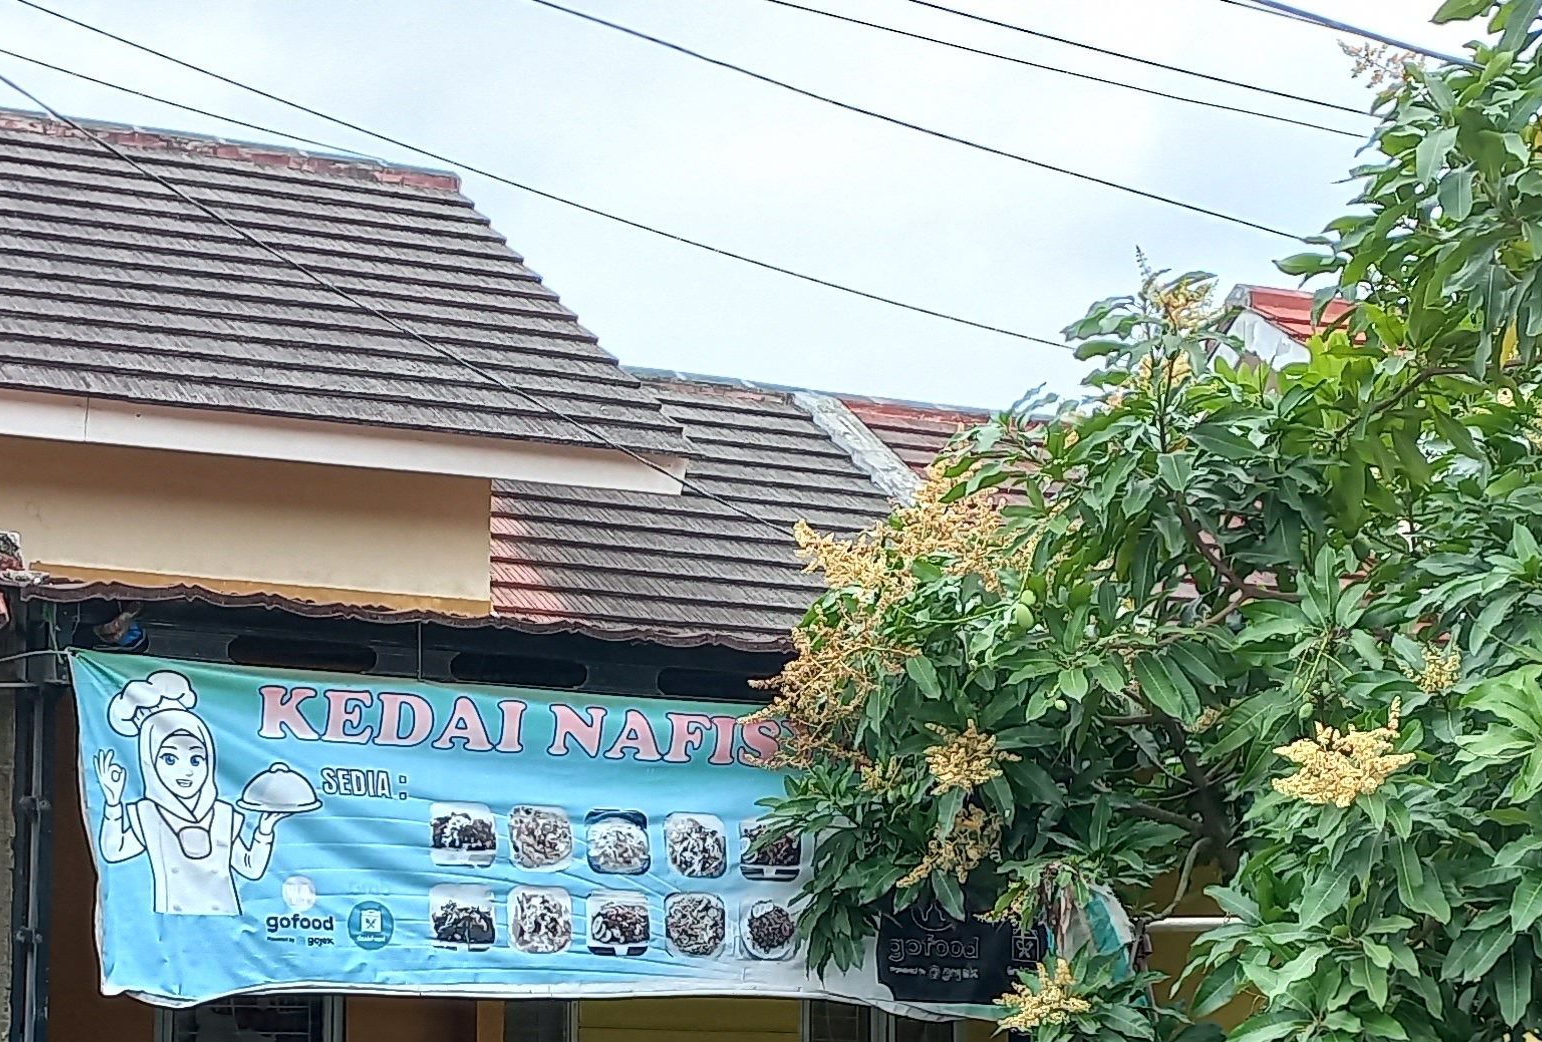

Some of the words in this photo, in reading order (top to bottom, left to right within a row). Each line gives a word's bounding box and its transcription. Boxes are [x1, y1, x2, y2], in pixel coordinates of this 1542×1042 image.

[258, 685, 528, 753] KEDAI
[546, 703, 871, 772] NAFIS
[320, 767, 393, 799] SEDIA
[265, 913, 334, 933] gofood
[888, 934, 980, 962] gofood
